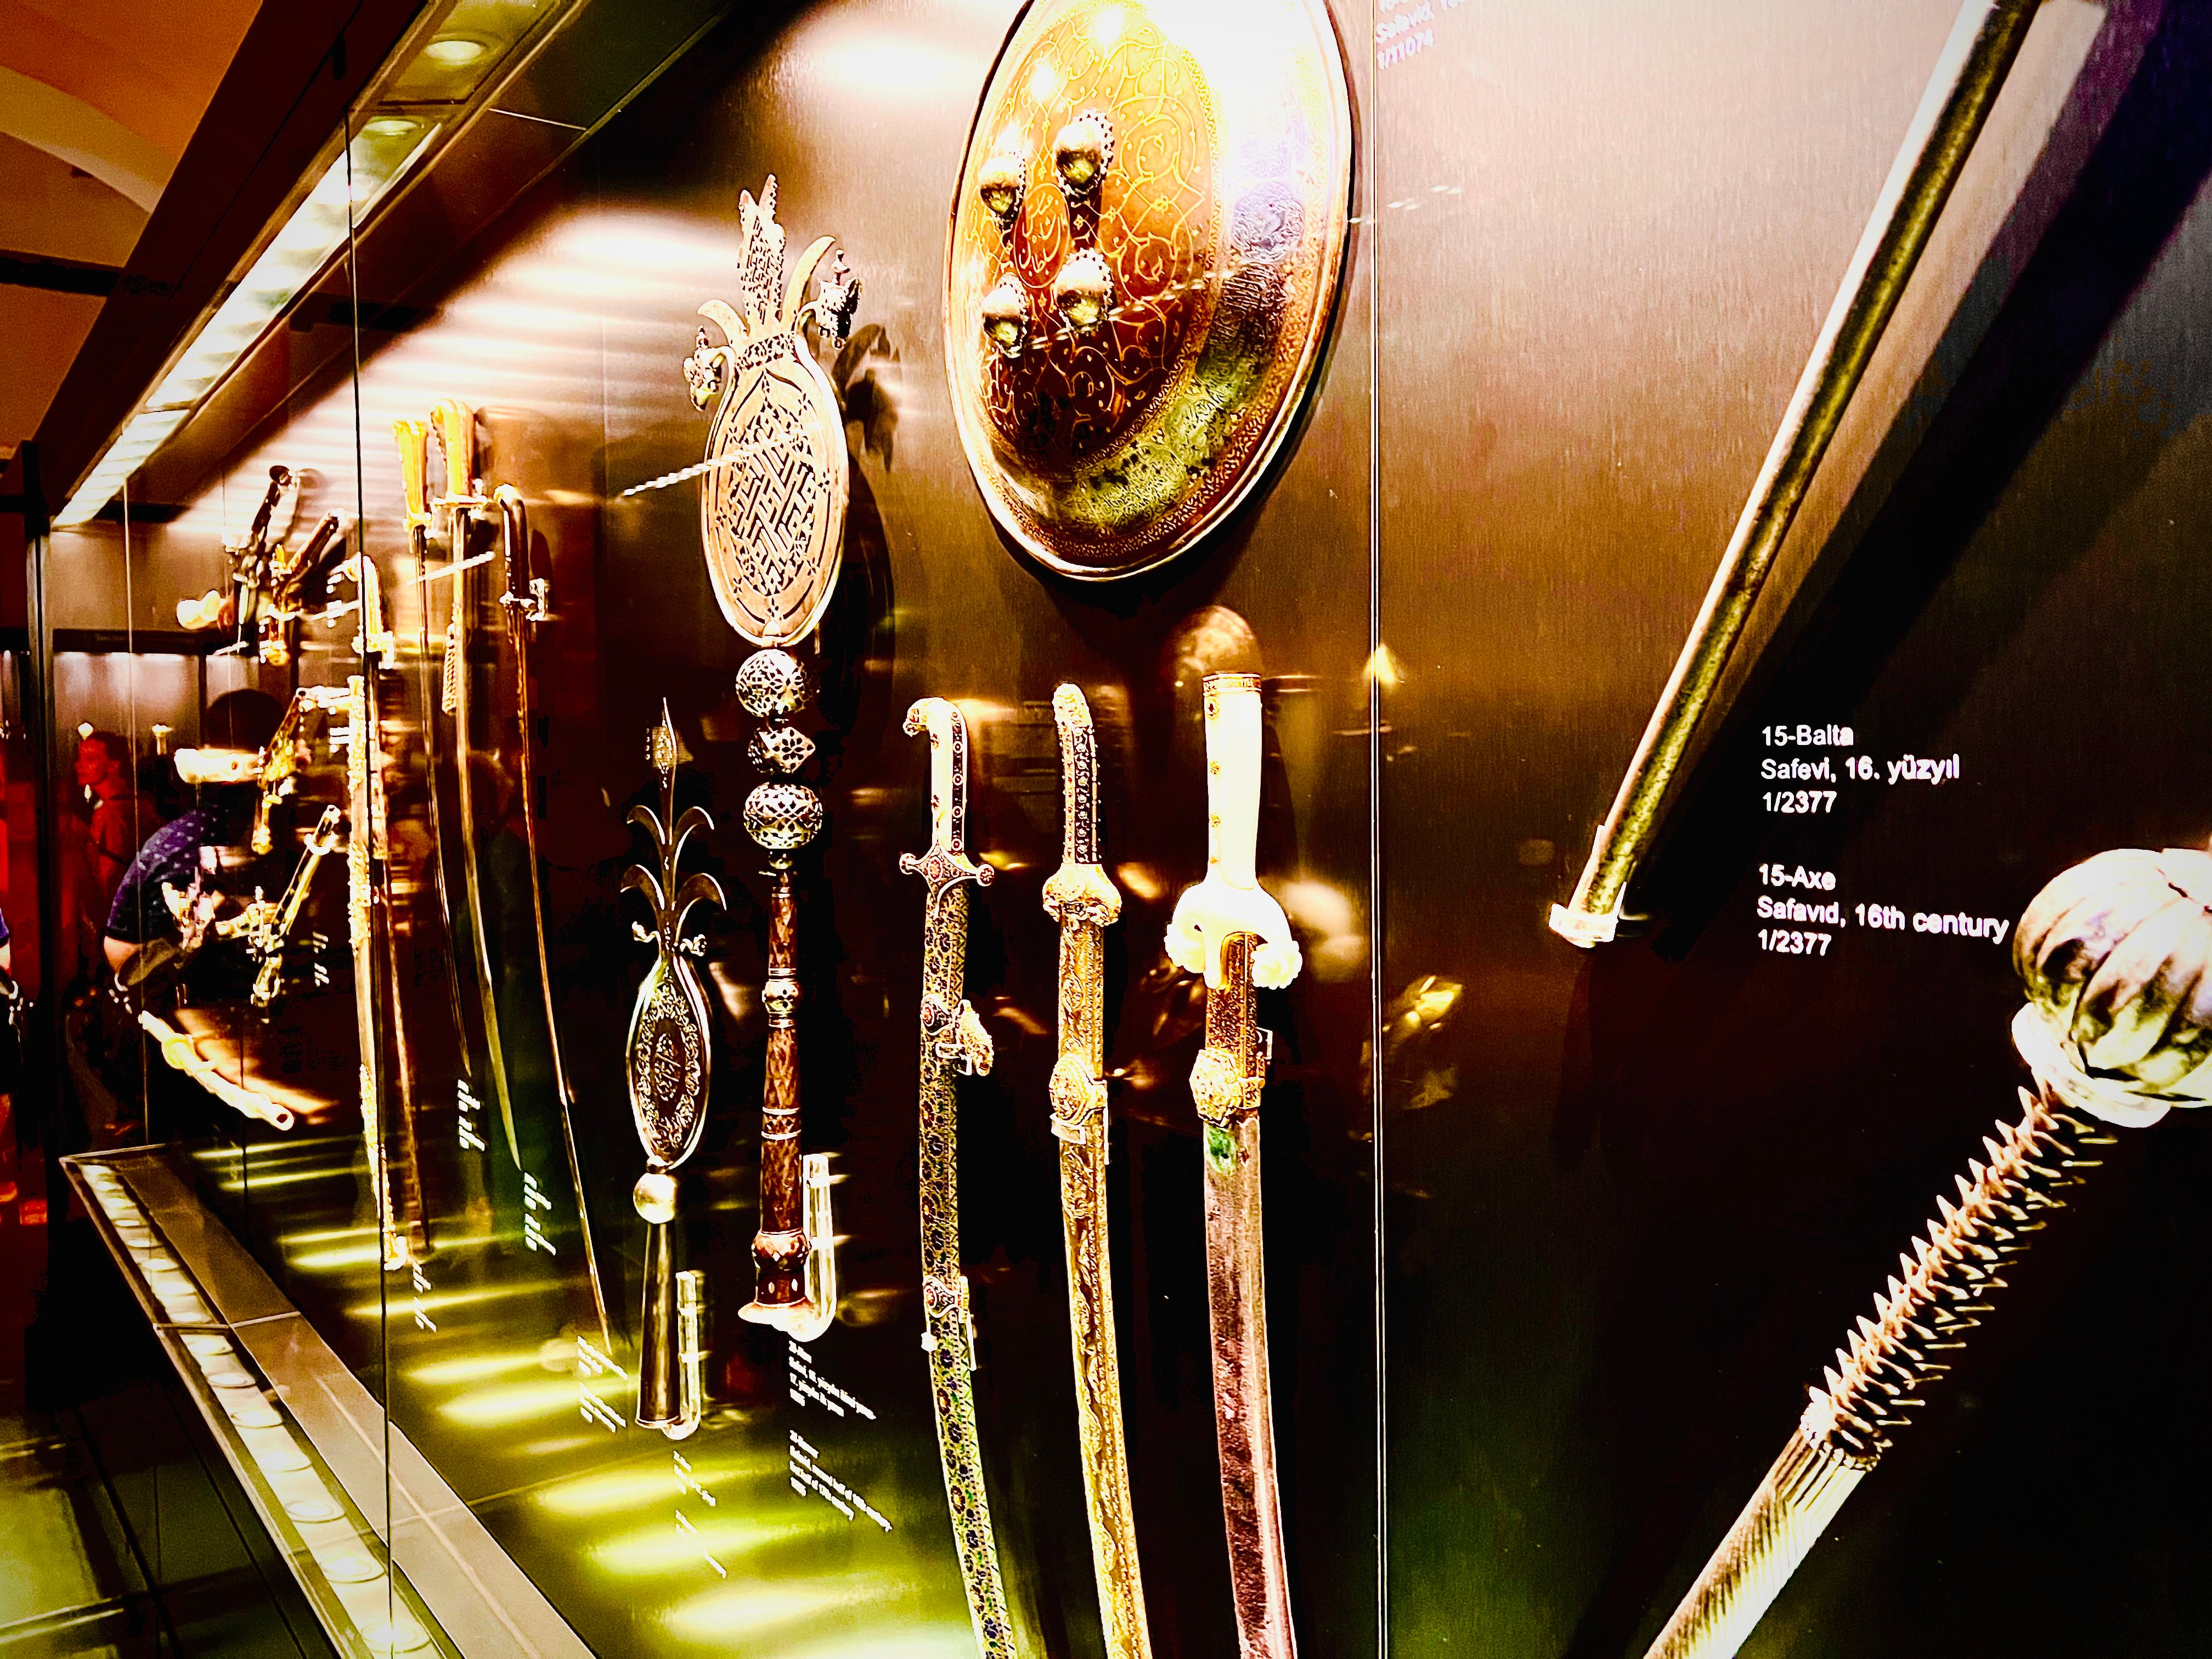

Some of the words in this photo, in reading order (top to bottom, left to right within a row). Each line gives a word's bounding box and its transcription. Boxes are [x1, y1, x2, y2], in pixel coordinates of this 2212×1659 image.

[1377, 27, 1435, 70] 1/11074
[1762, 724, 1854, 746] 15-Balta
[1760, 757, 1837, 783] Safevi,
[1845, 755, 1880, 780] 16.
[1887, 753, 1960, 785] yüzyıl
[1762, 791, 1837, 814] 1/2377
[1759, 864, 1836, 891] 15-Axe
[1757, 895, 1846, 928] Safavid,
[1855, 902, 1905, 930] 16th
[1912, 911, 2010, 945] century
[1758, 929, 1832, 956] 1/2377
